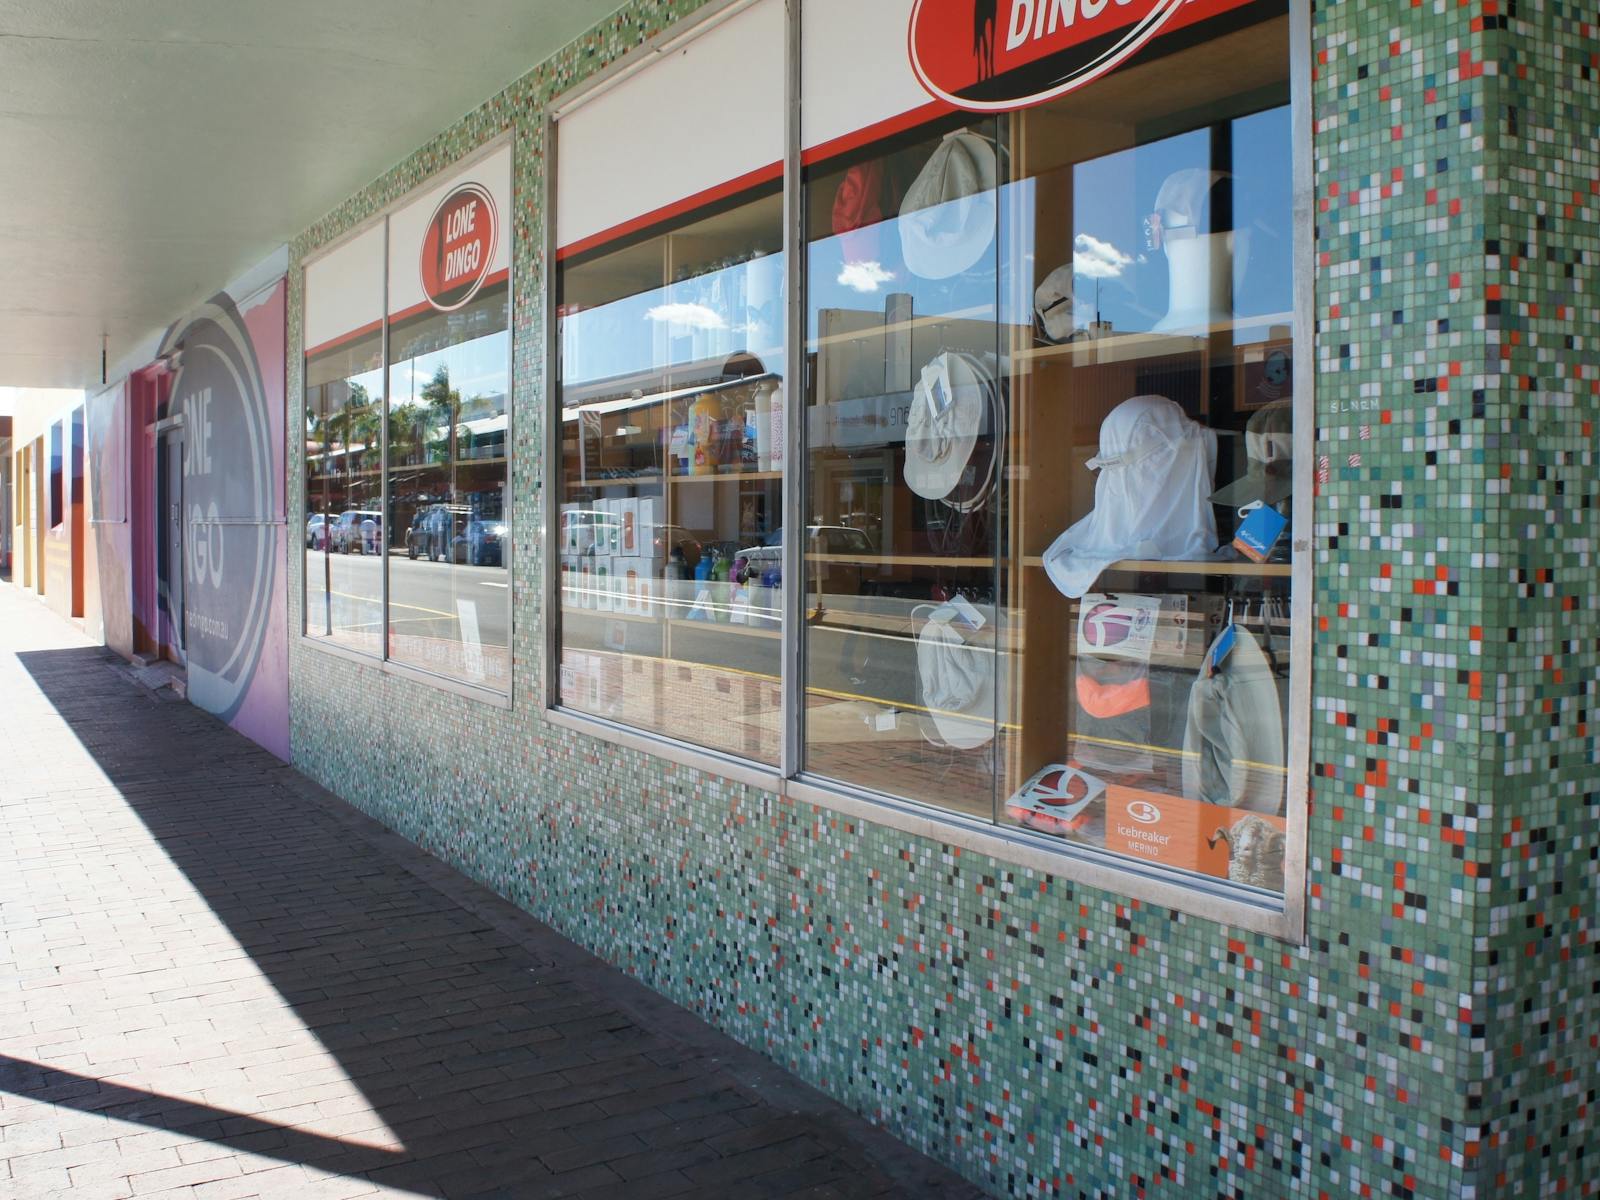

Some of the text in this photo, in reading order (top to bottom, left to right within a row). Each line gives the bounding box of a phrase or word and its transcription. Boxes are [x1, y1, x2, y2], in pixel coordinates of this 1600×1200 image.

[1006, 0, 1134, 52] DIN
[446, 200, 477, 244] LONE
[444, 239, 481, 282] DINGO
[1117, 823, 1169, 846] icebreaker
[1128, 841, 1159, 857] MERINO
